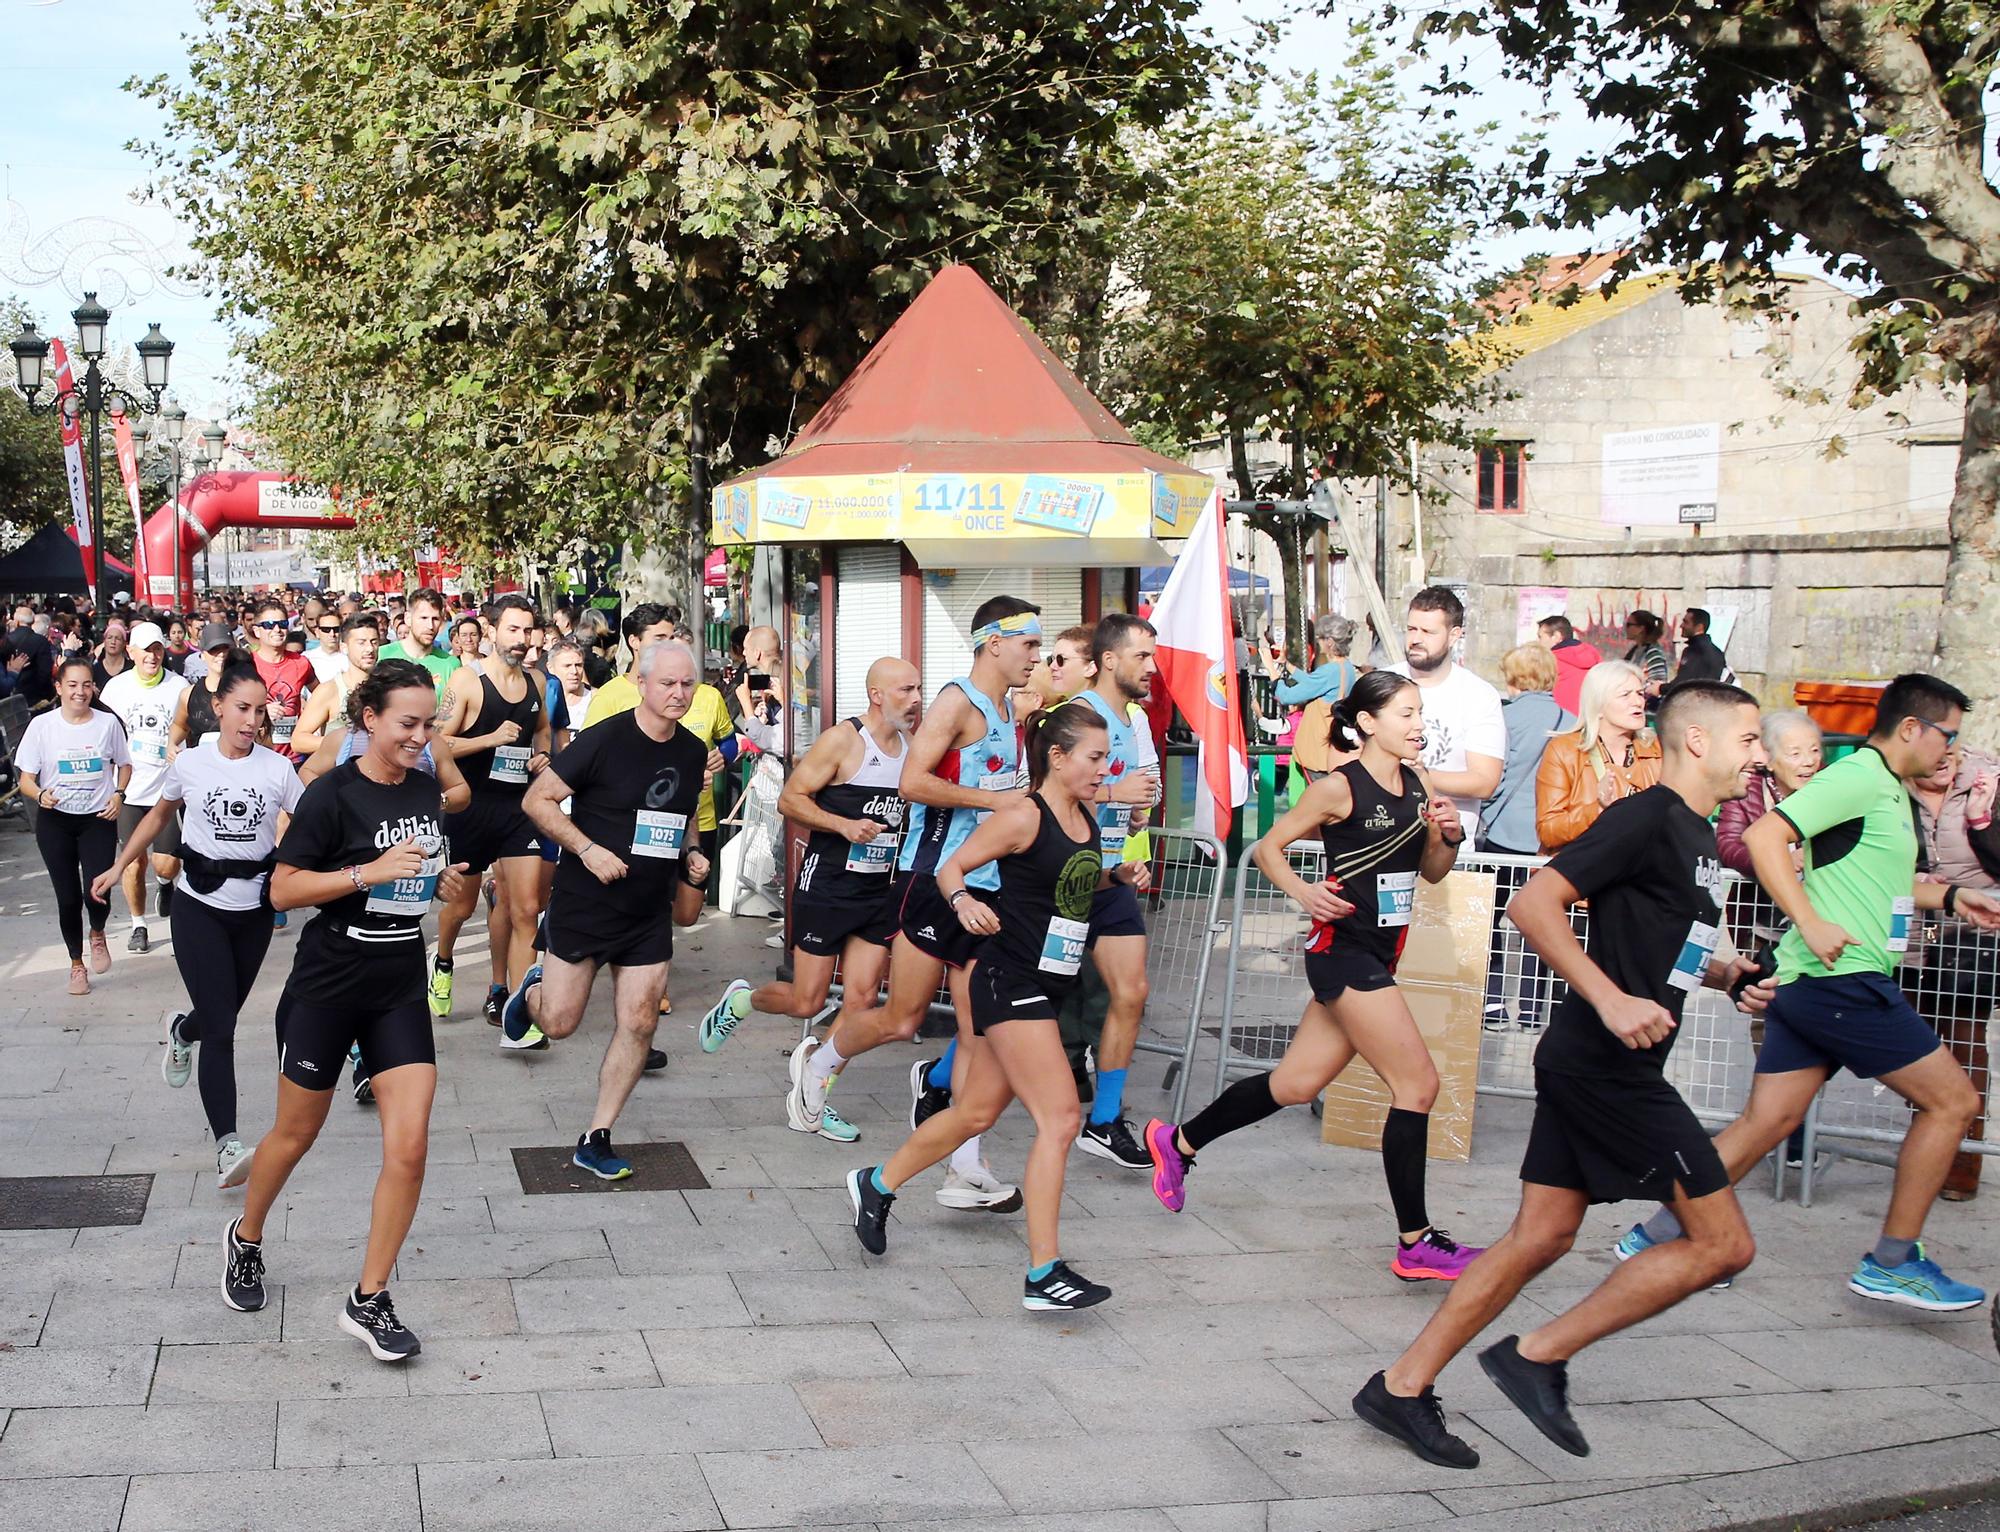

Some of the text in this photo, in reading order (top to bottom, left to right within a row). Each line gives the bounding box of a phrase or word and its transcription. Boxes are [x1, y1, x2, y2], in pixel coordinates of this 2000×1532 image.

[914, 483, 1006, 511] 11/11
[272, 500, 318, 510] DE VIGO
[965, 515, 1005, 531] ONCE
[70, 760, 91, 769] 1141
[650, 827, 675, 842] 1075
[866, 846, 887, 859] 1215
[393, 879, 425, 894] 1130
